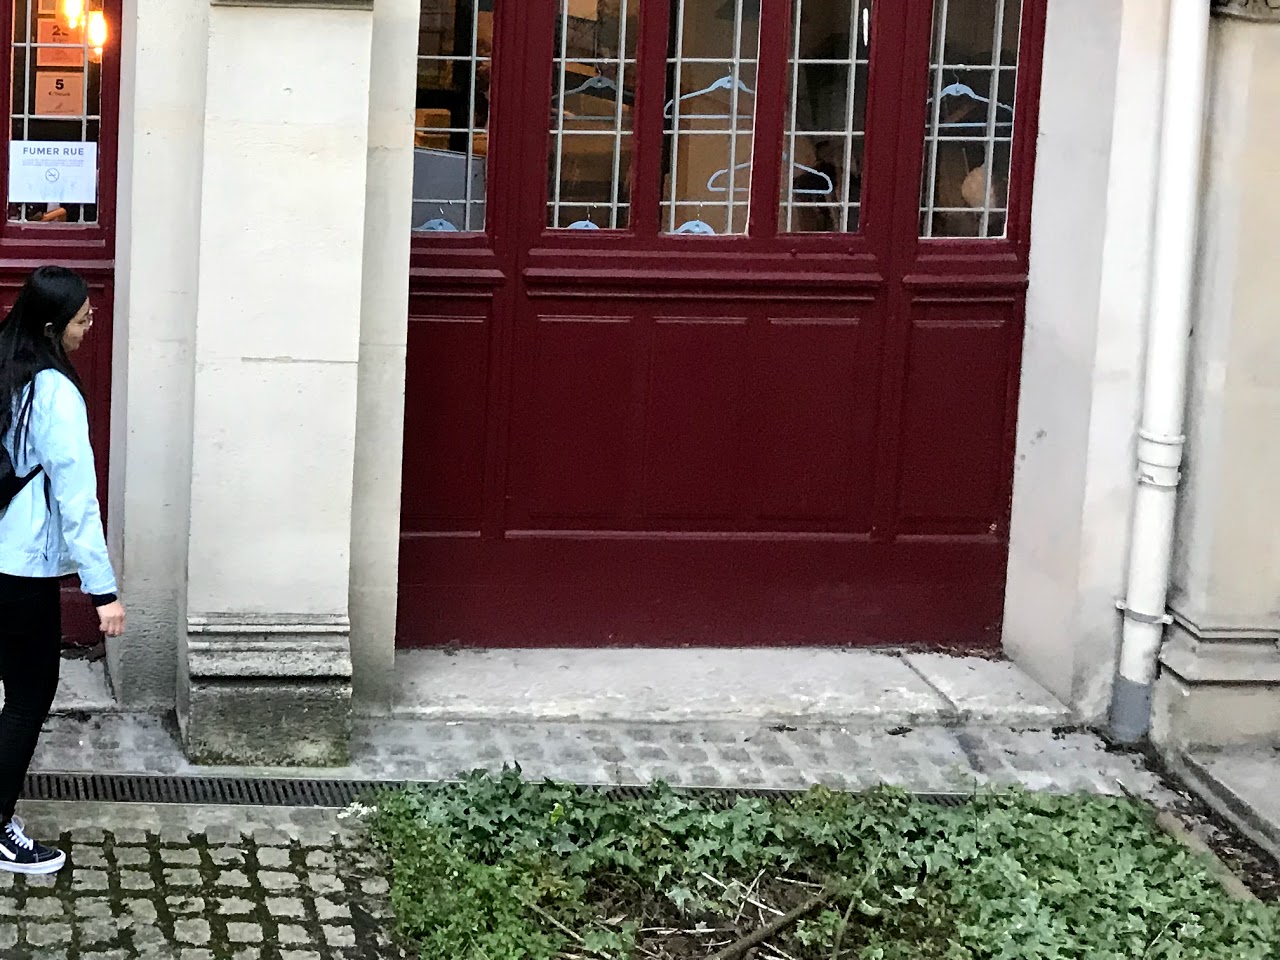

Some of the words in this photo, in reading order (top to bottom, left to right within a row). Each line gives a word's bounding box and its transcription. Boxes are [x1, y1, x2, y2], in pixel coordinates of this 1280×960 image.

[55, 78, 65, 90] 5
[23, 147, 60, 156] FUMER
[63, 148, 84, 156] RUE
